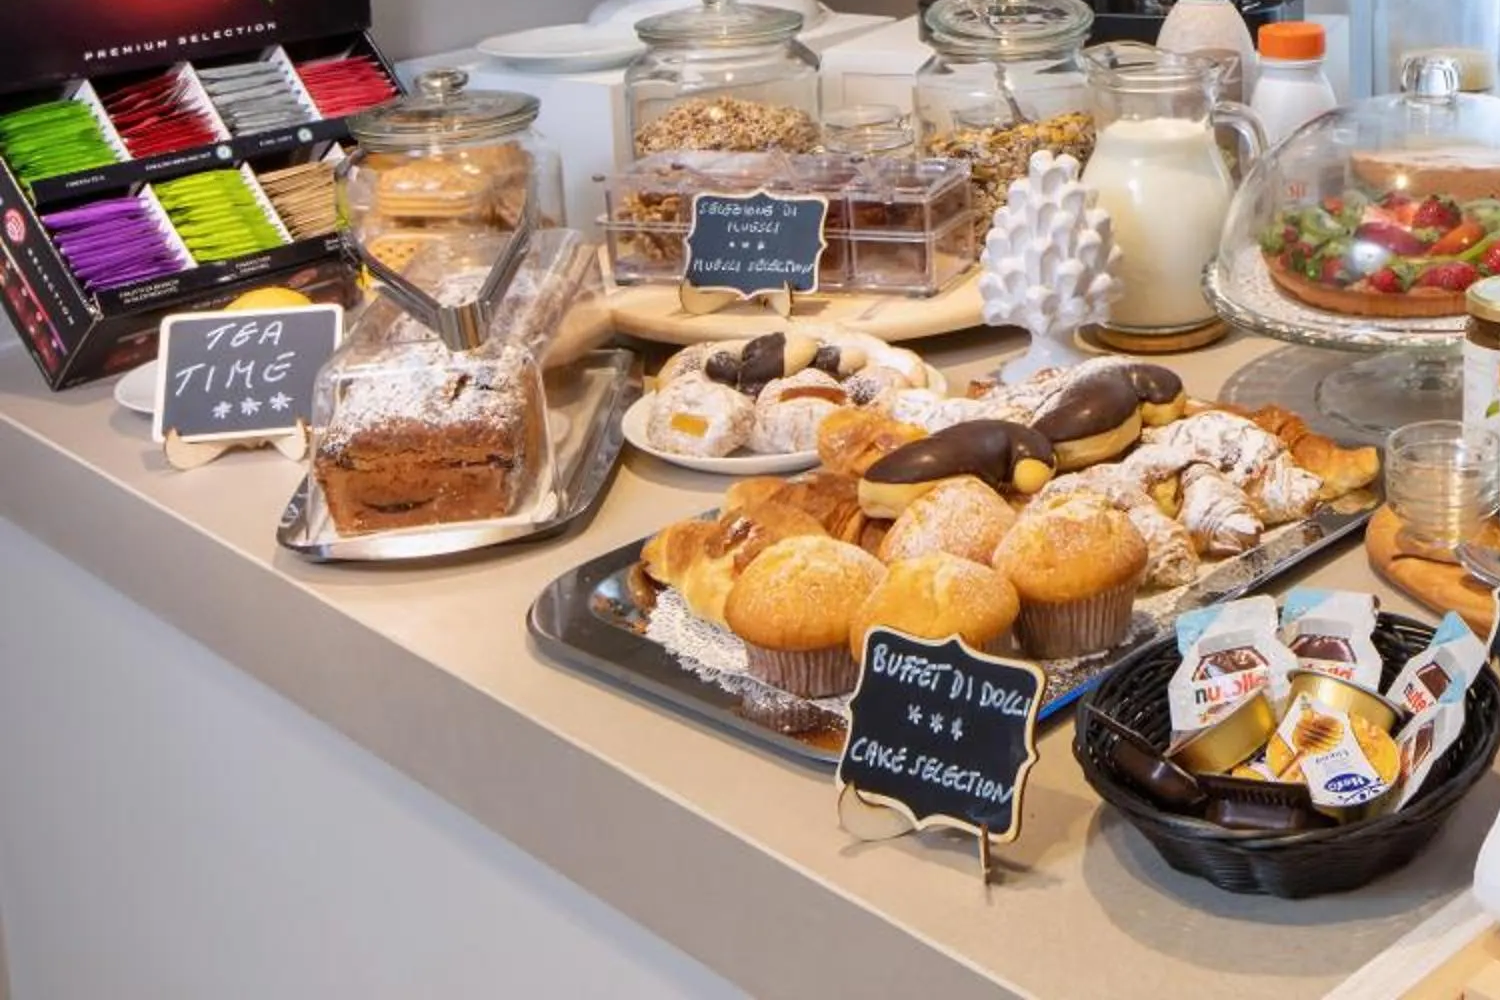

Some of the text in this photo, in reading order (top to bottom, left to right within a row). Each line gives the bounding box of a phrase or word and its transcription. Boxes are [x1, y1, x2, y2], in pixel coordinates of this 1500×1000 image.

[84, 22, 277, 61] PREMIUM SELECTION
[206, 320, 284, 351] TEA
[175, 352, 296, 396] TIME
[872, 643, 952, 691] BUFFET
[949, 669, 974, 701] DI
[851, 736, 1015, 804] CAKE SELECTION
